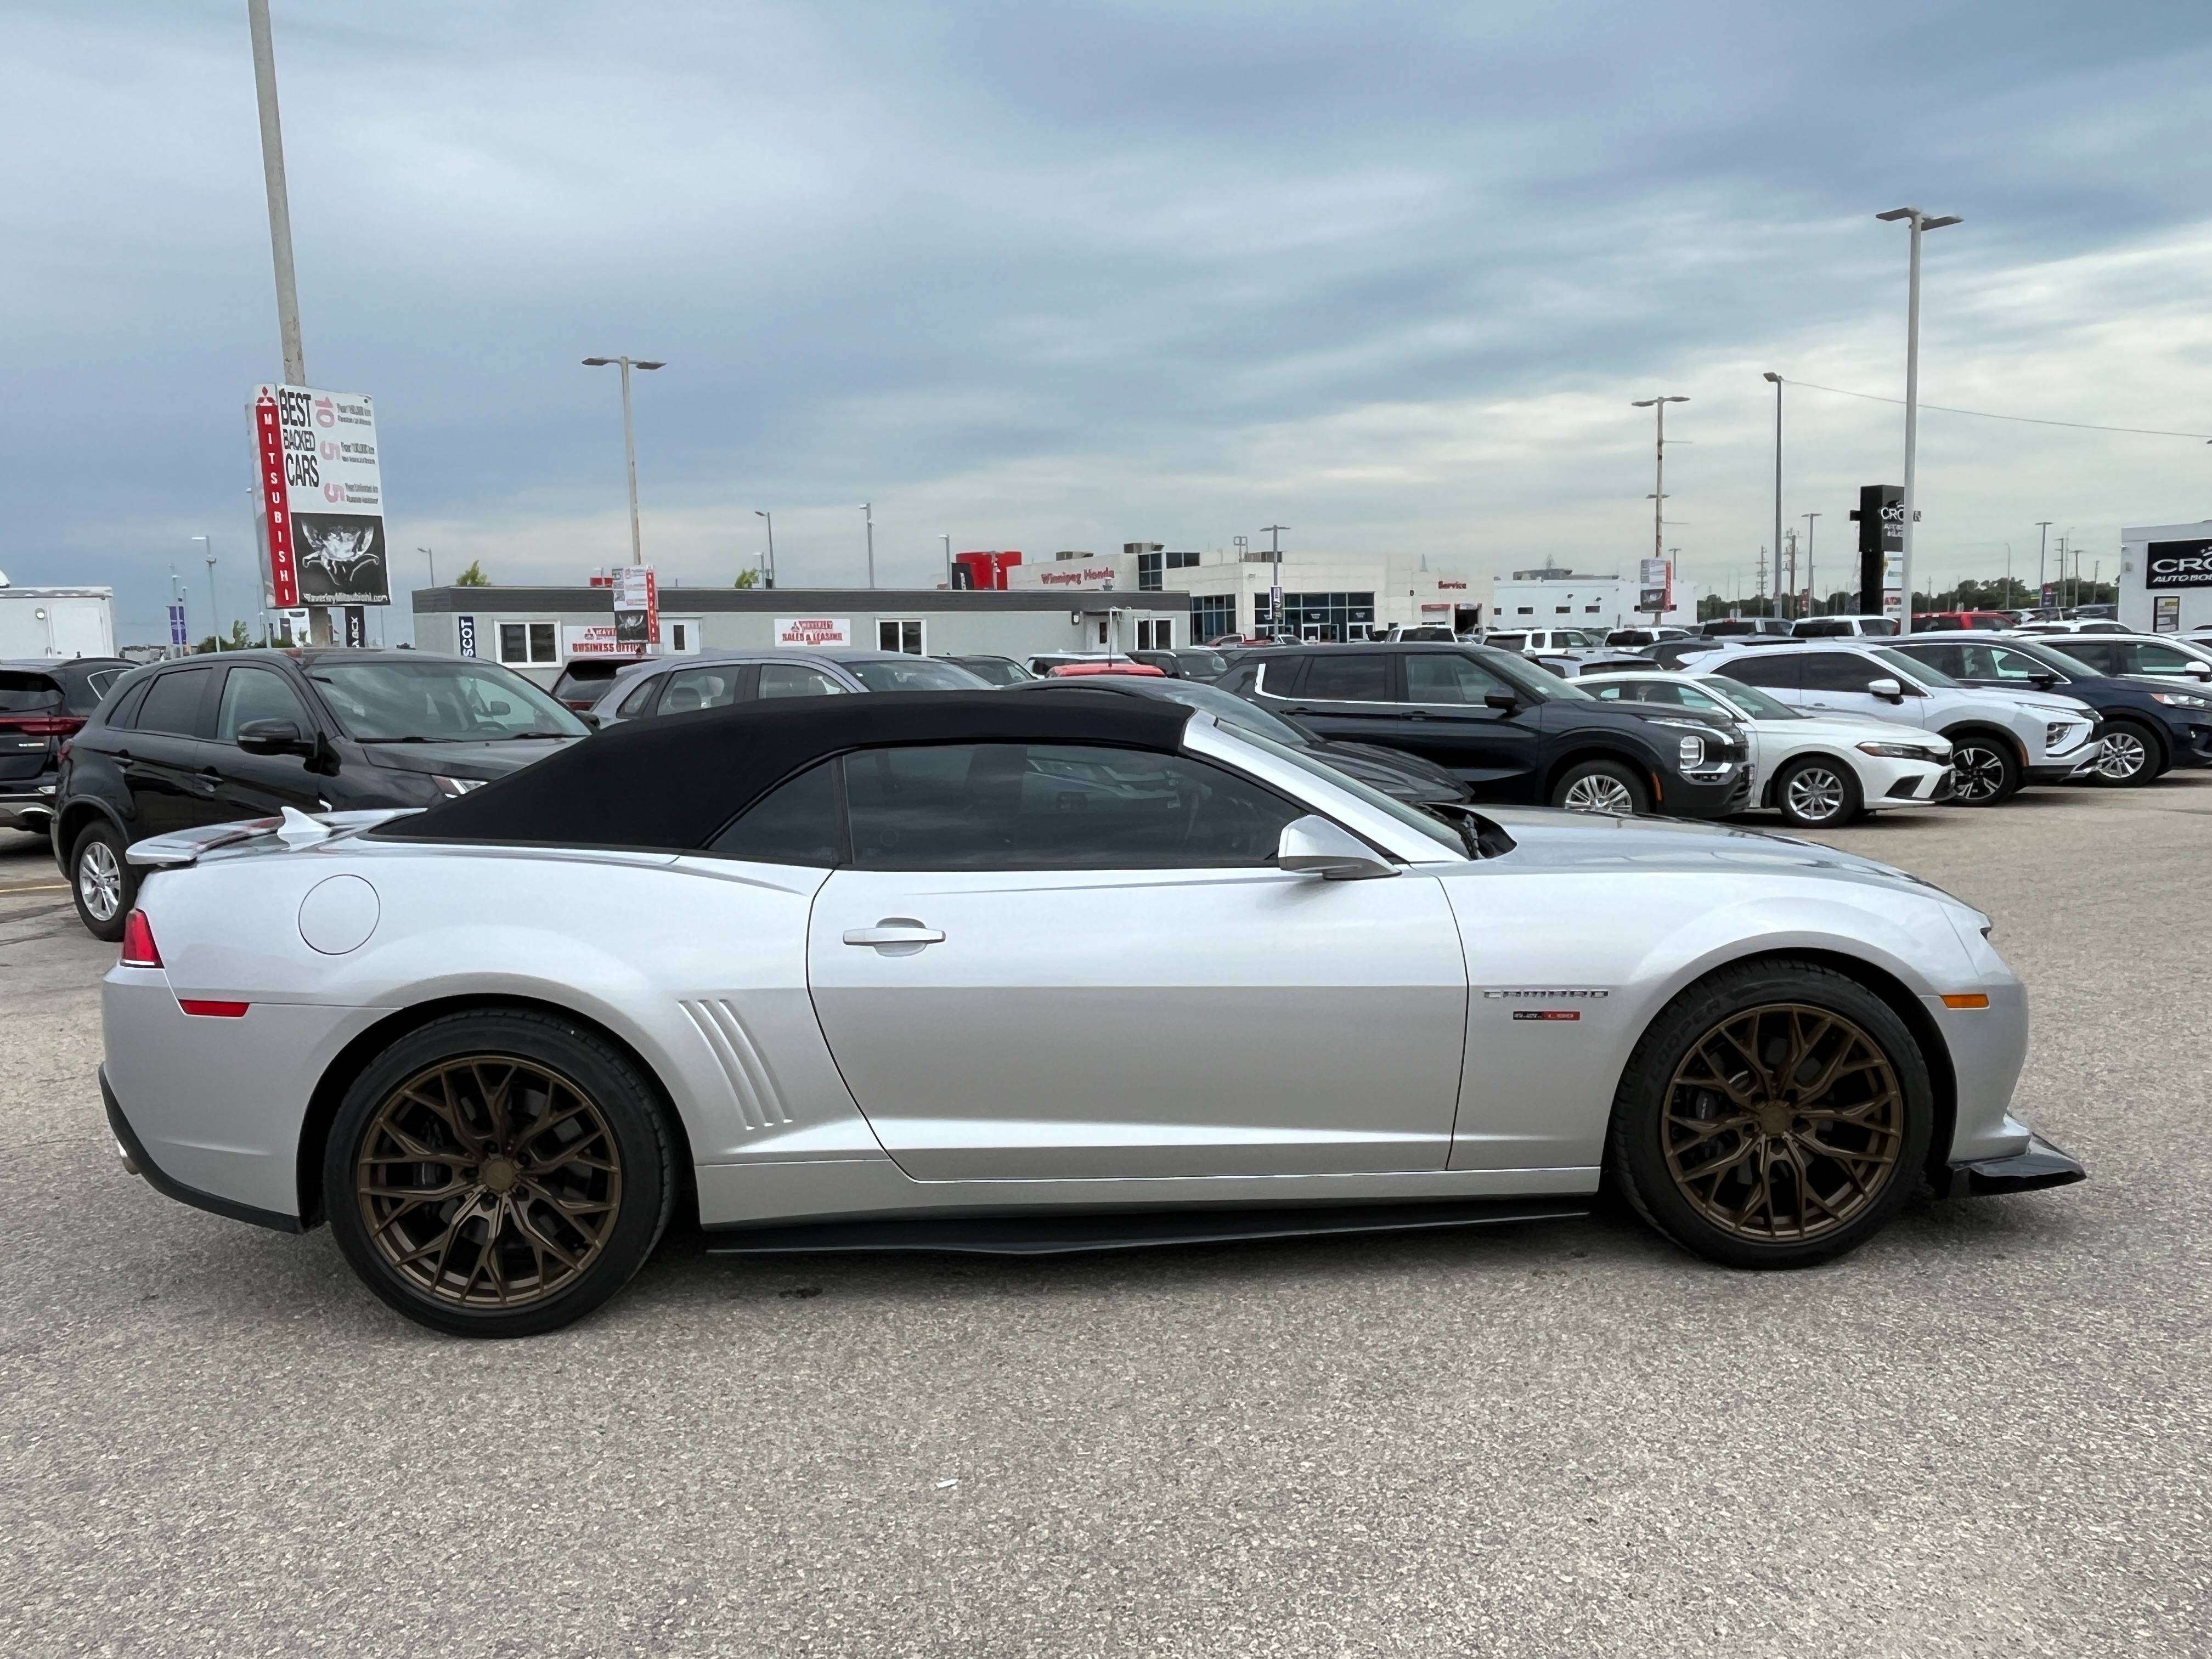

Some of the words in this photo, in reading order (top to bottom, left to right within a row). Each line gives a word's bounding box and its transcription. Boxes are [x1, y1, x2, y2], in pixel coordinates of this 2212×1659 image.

[279, 388, 311, 427] BEST
[283, 429, 315, 452] BACKED
[285, 453, 319, 488] CARS
[264, 413, 289, 601] MITSUBISHI
